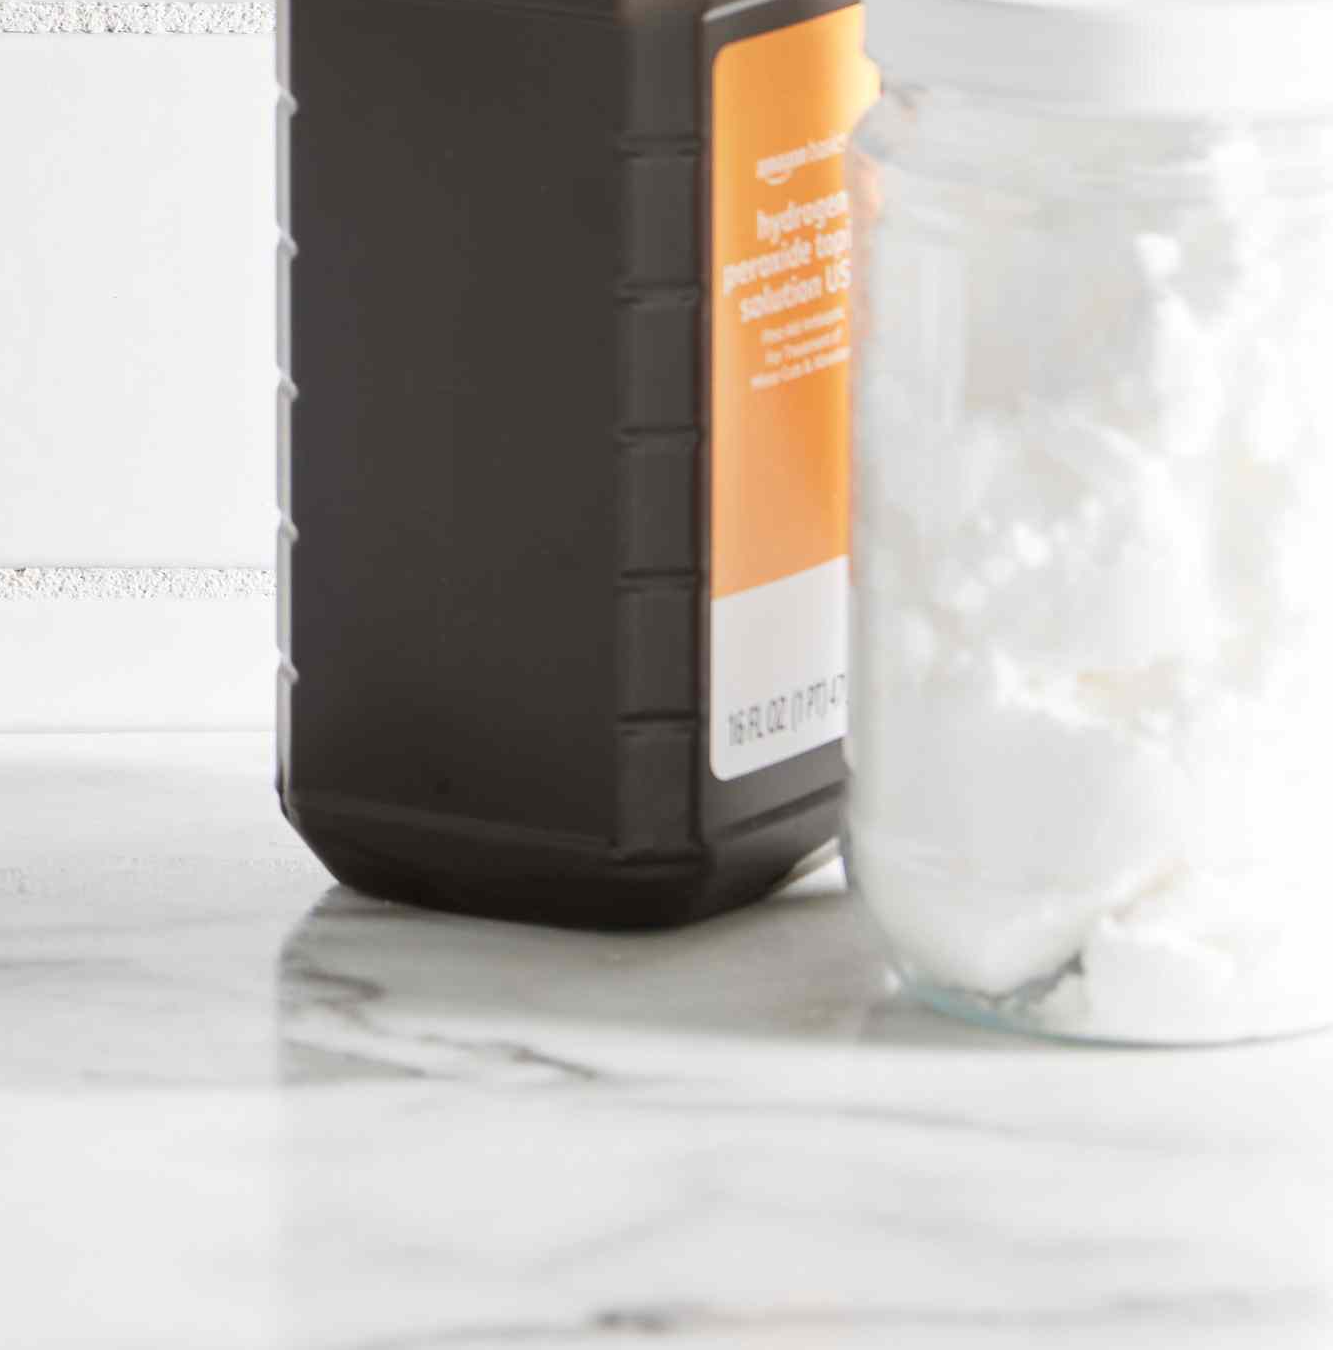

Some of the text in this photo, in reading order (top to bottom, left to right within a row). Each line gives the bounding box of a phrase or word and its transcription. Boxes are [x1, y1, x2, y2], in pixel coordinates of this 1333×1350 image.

[756, 190, 849, 244] hydrogen
[723, 216, 852, 297] peroxide topi
[740, 257, 852, 324] solution US
[729, 710, 744, 746] 16
[747, 705, 764, 743] FL
[766, 696, 787, 734] OZ
